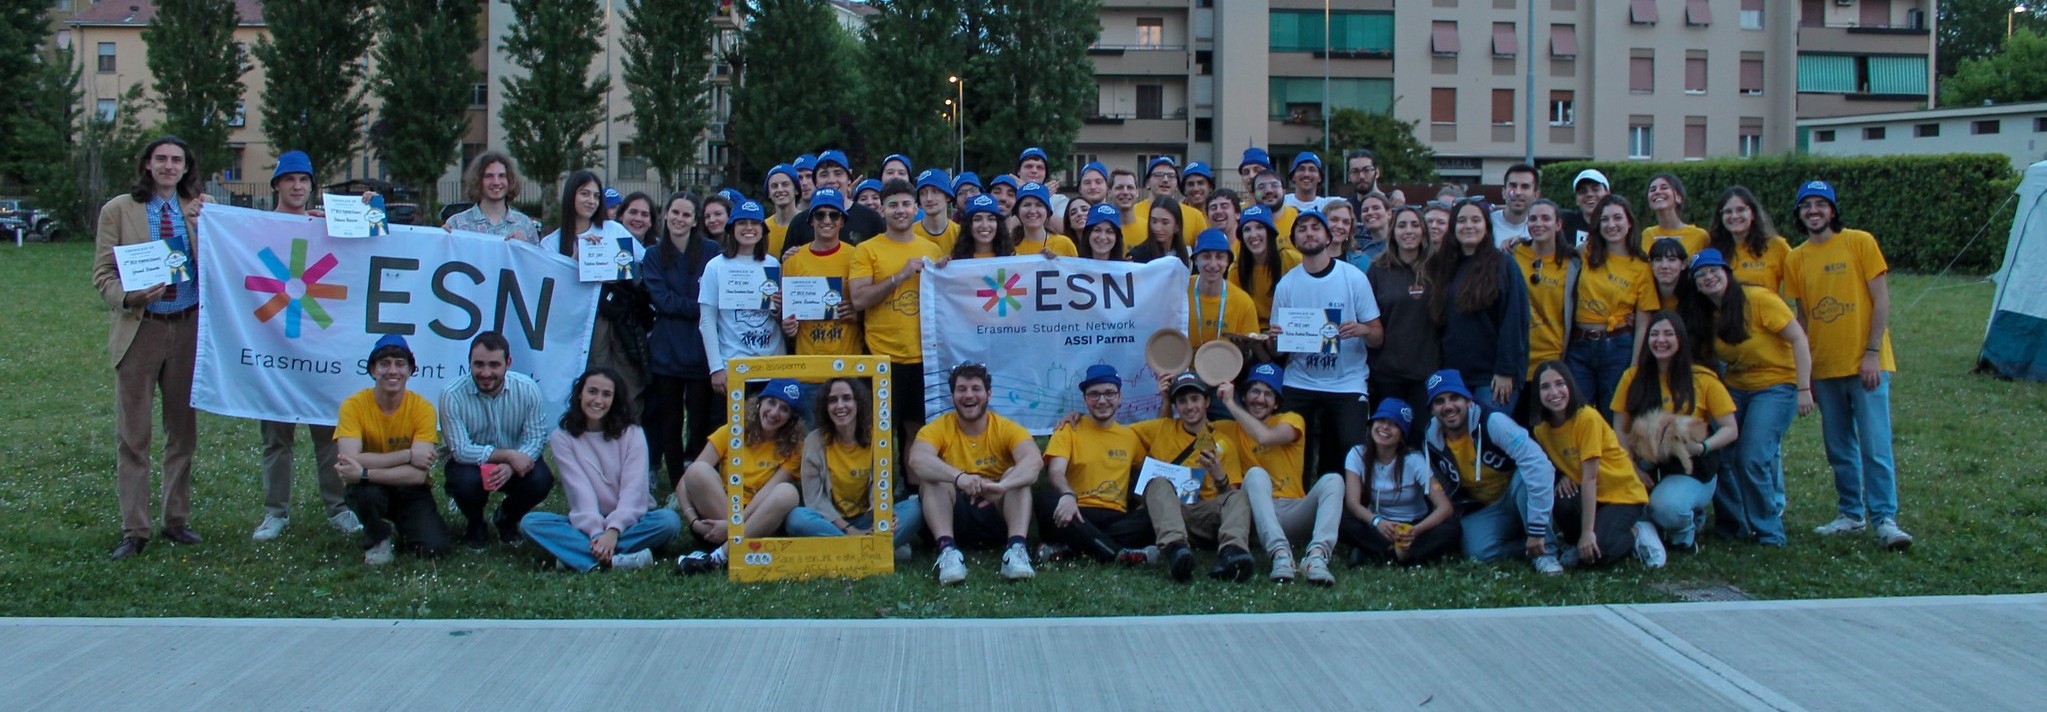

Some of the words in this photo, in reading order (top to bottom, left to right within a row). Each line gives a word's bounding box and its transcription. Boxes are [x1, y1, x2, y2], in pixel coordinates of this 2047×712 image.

[365, 255, 556, 352] ESN
[1035, 270, 1135, 311] ESN
[977, 324, 1027, 335] Erasmus
[1033, 321, 1080, 333] Student
[1085, 319, 1135, 331] Network
[1064, 335, 1092, 346] ASSI
[1096, 333, 1135, 345] Parma
[240, 347, 342, 374] Erasmus
[355, 358, 445, 379] Sent
